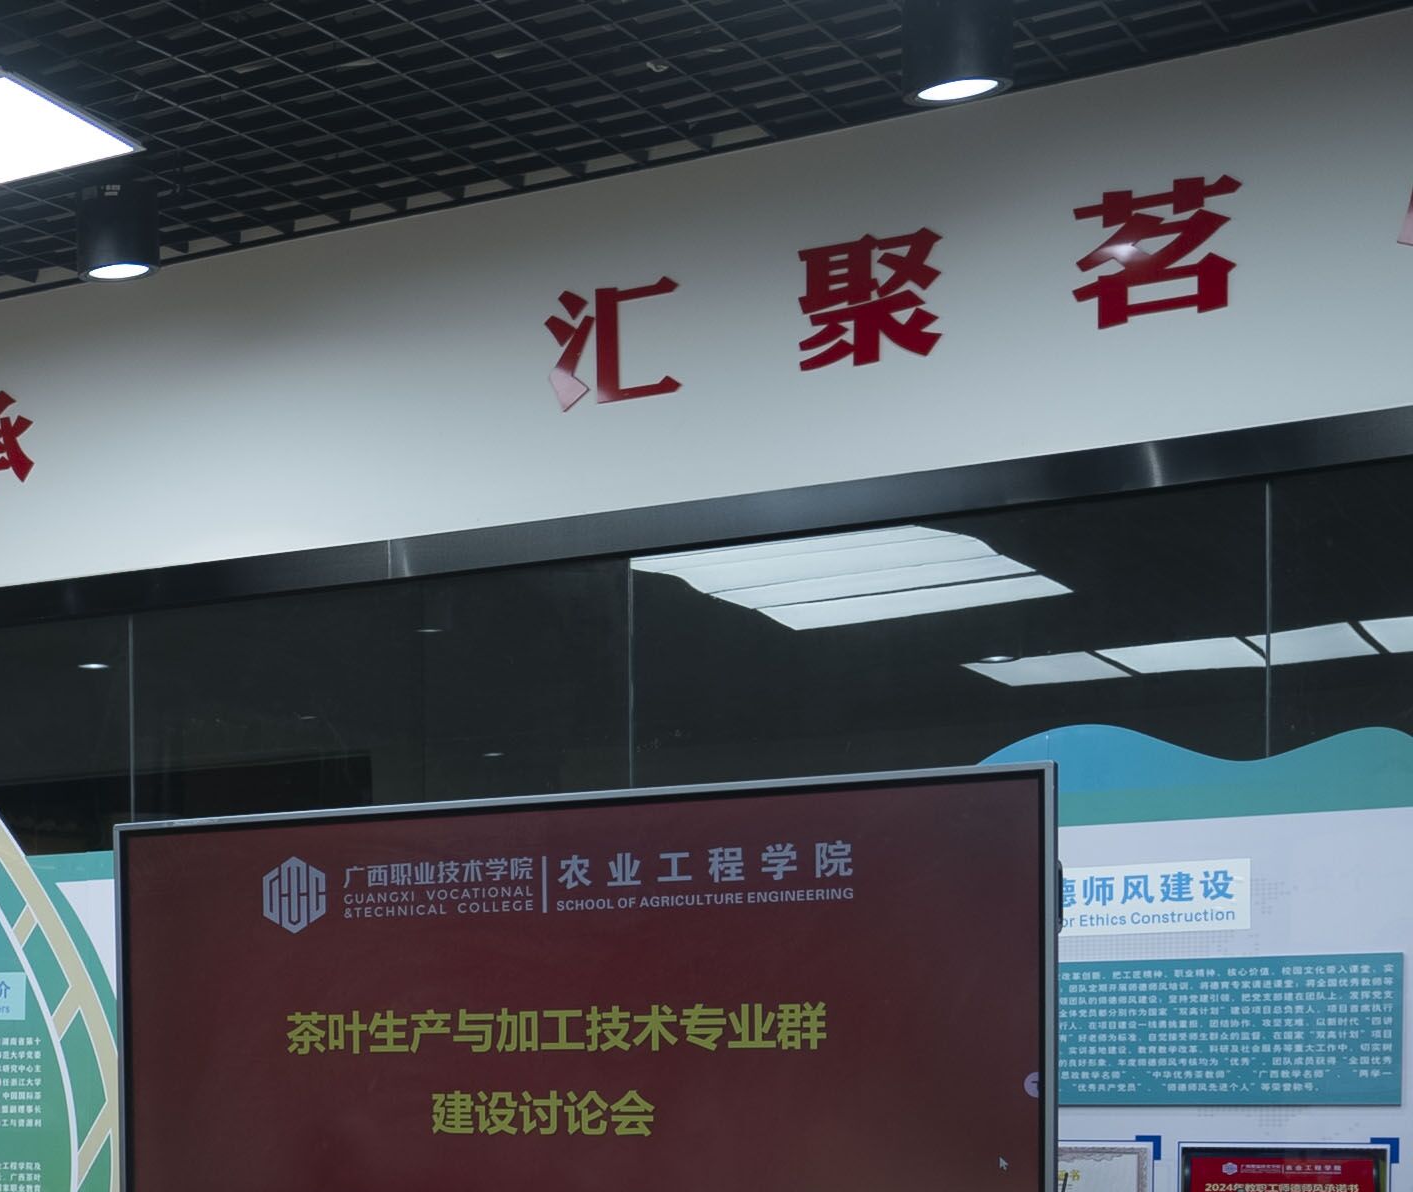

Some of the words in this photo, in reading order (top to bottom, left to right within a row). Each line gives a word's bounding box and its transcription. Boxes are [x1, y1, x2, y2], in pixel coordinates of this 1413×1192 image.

[543, 173, 1413, 414] 汇聚茗
[343, 857, 534, 889] 广西职业技术学院
[557, 839, 854, 890] 农业工程学院
[343, 891, 415, 905] GUANGXI
[426, 885, 534, 901] VOCATIONAL
[556, 897, 614, 912] SCHOOL
[617, 896, 636, 909] OF
[639, 892, 745, 908] AGRICULTURE
[747, 887, 854, 904] ENGINEERING
[1062, 869, 1235, 908] 德师风建设
[343, 903, 447, 919] &TECHNICAL
[457, 899, 534, 914] COLLEGE
[1080, 913, 1127, 927] Ethics
[1130, 908, 1235, 925] Construction
[285, 1001, 827, 1055] 茶叶生产与加工技术专业群
[430, 1089, 655, 1137] 建设讨论会
